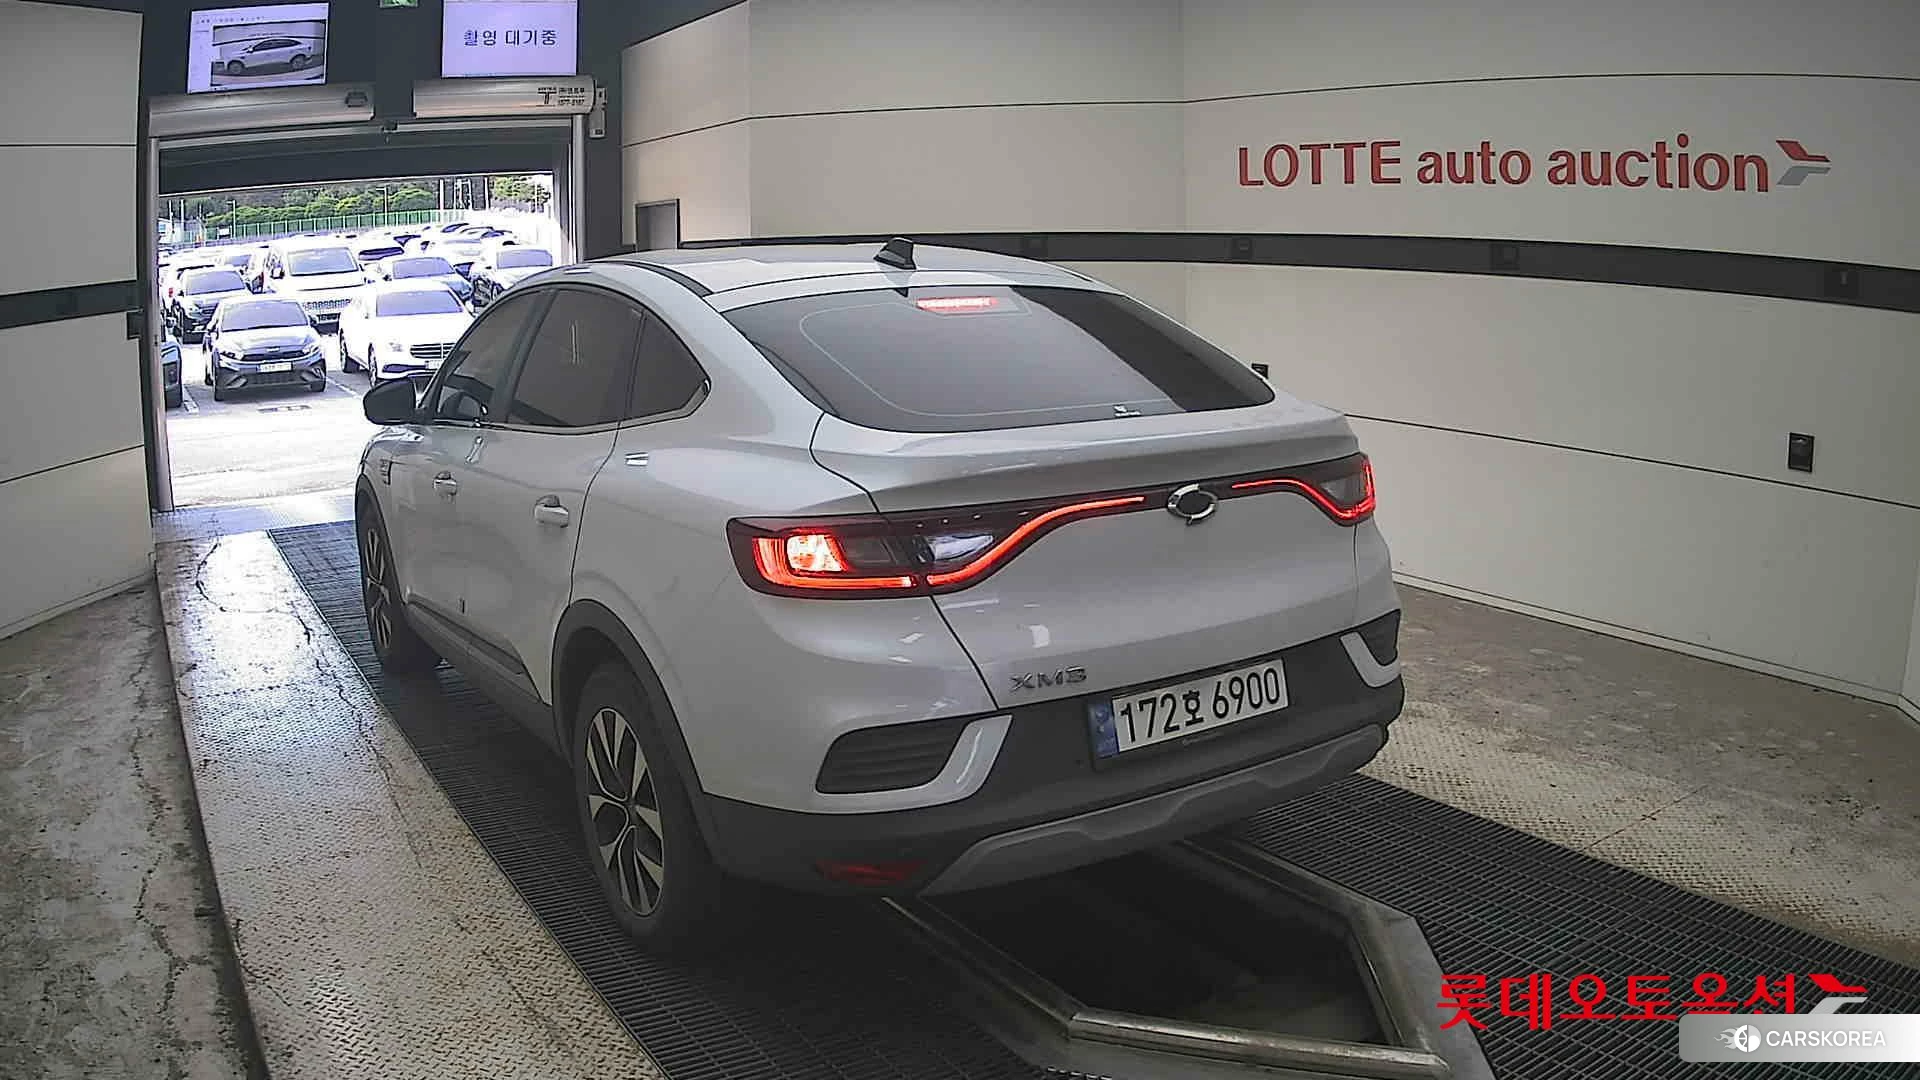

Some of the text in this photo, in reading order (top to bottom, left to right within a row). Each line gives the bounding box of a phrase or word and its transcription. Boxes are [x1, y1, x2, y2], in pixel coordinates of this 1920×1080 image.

[505, 29, 558, 46] 대기중
[1238, 133, 1769, 193] LOTTE auto auction
[1009, 665, 1088, 692] XM3
